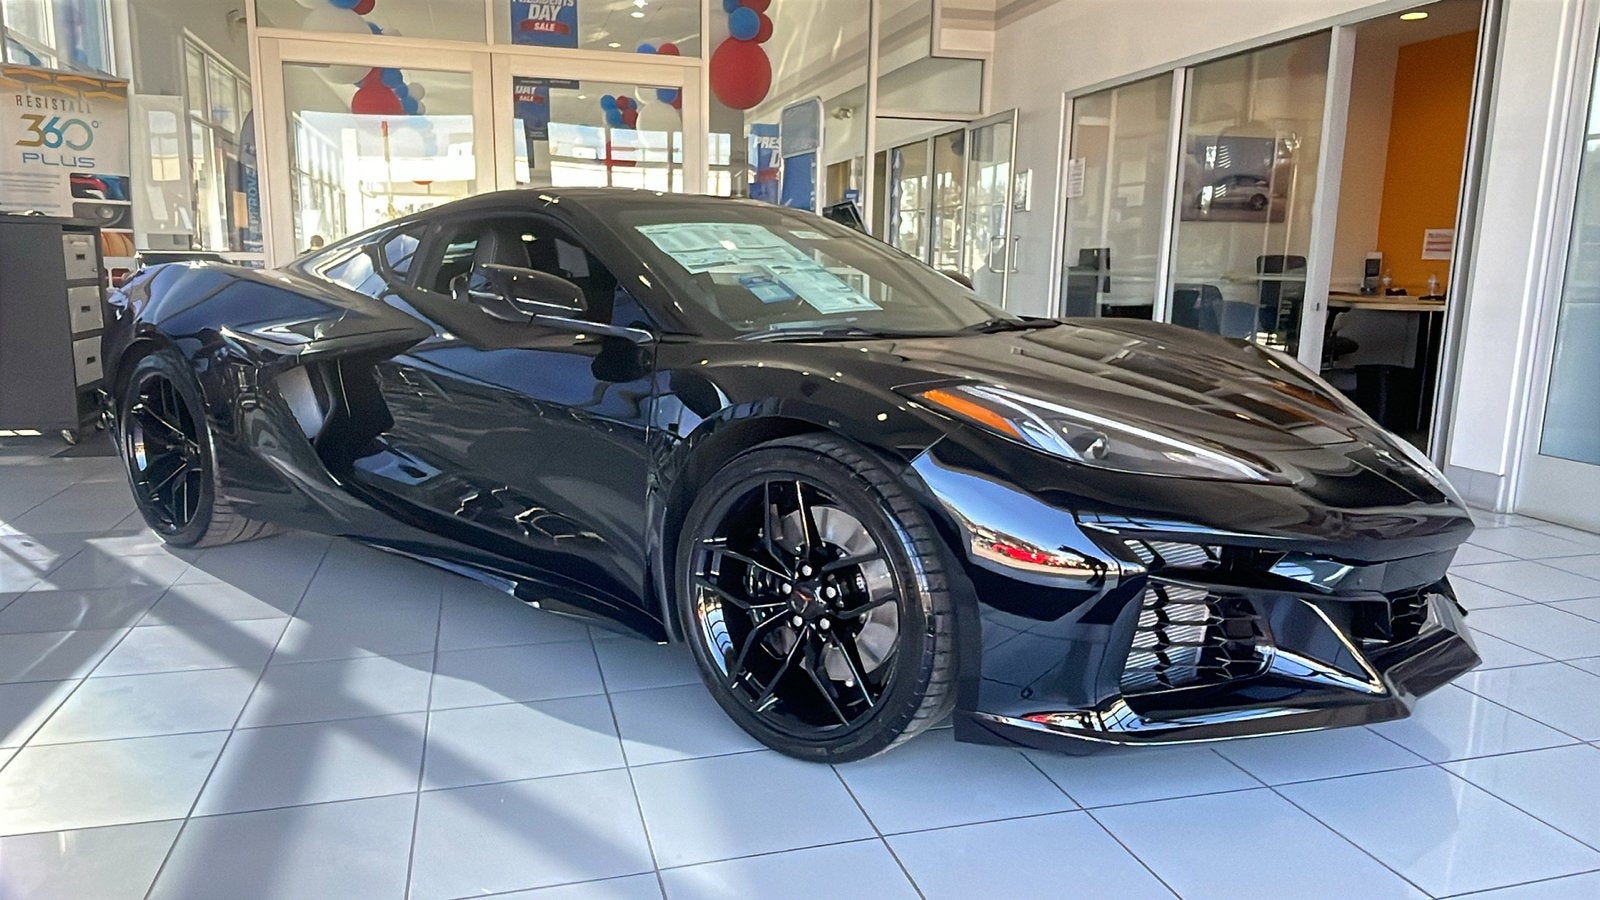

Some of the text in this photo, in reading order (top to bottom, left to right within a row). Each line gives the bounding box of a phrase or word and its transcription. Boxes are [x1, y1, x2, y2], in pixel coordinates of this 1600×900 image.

[528, 4, 562, 21] DAY
[533, 22, 556, 32] SALE
[15, 94, 92, 114] RESISTALL
[22, 152, 96, 168] PLUS
